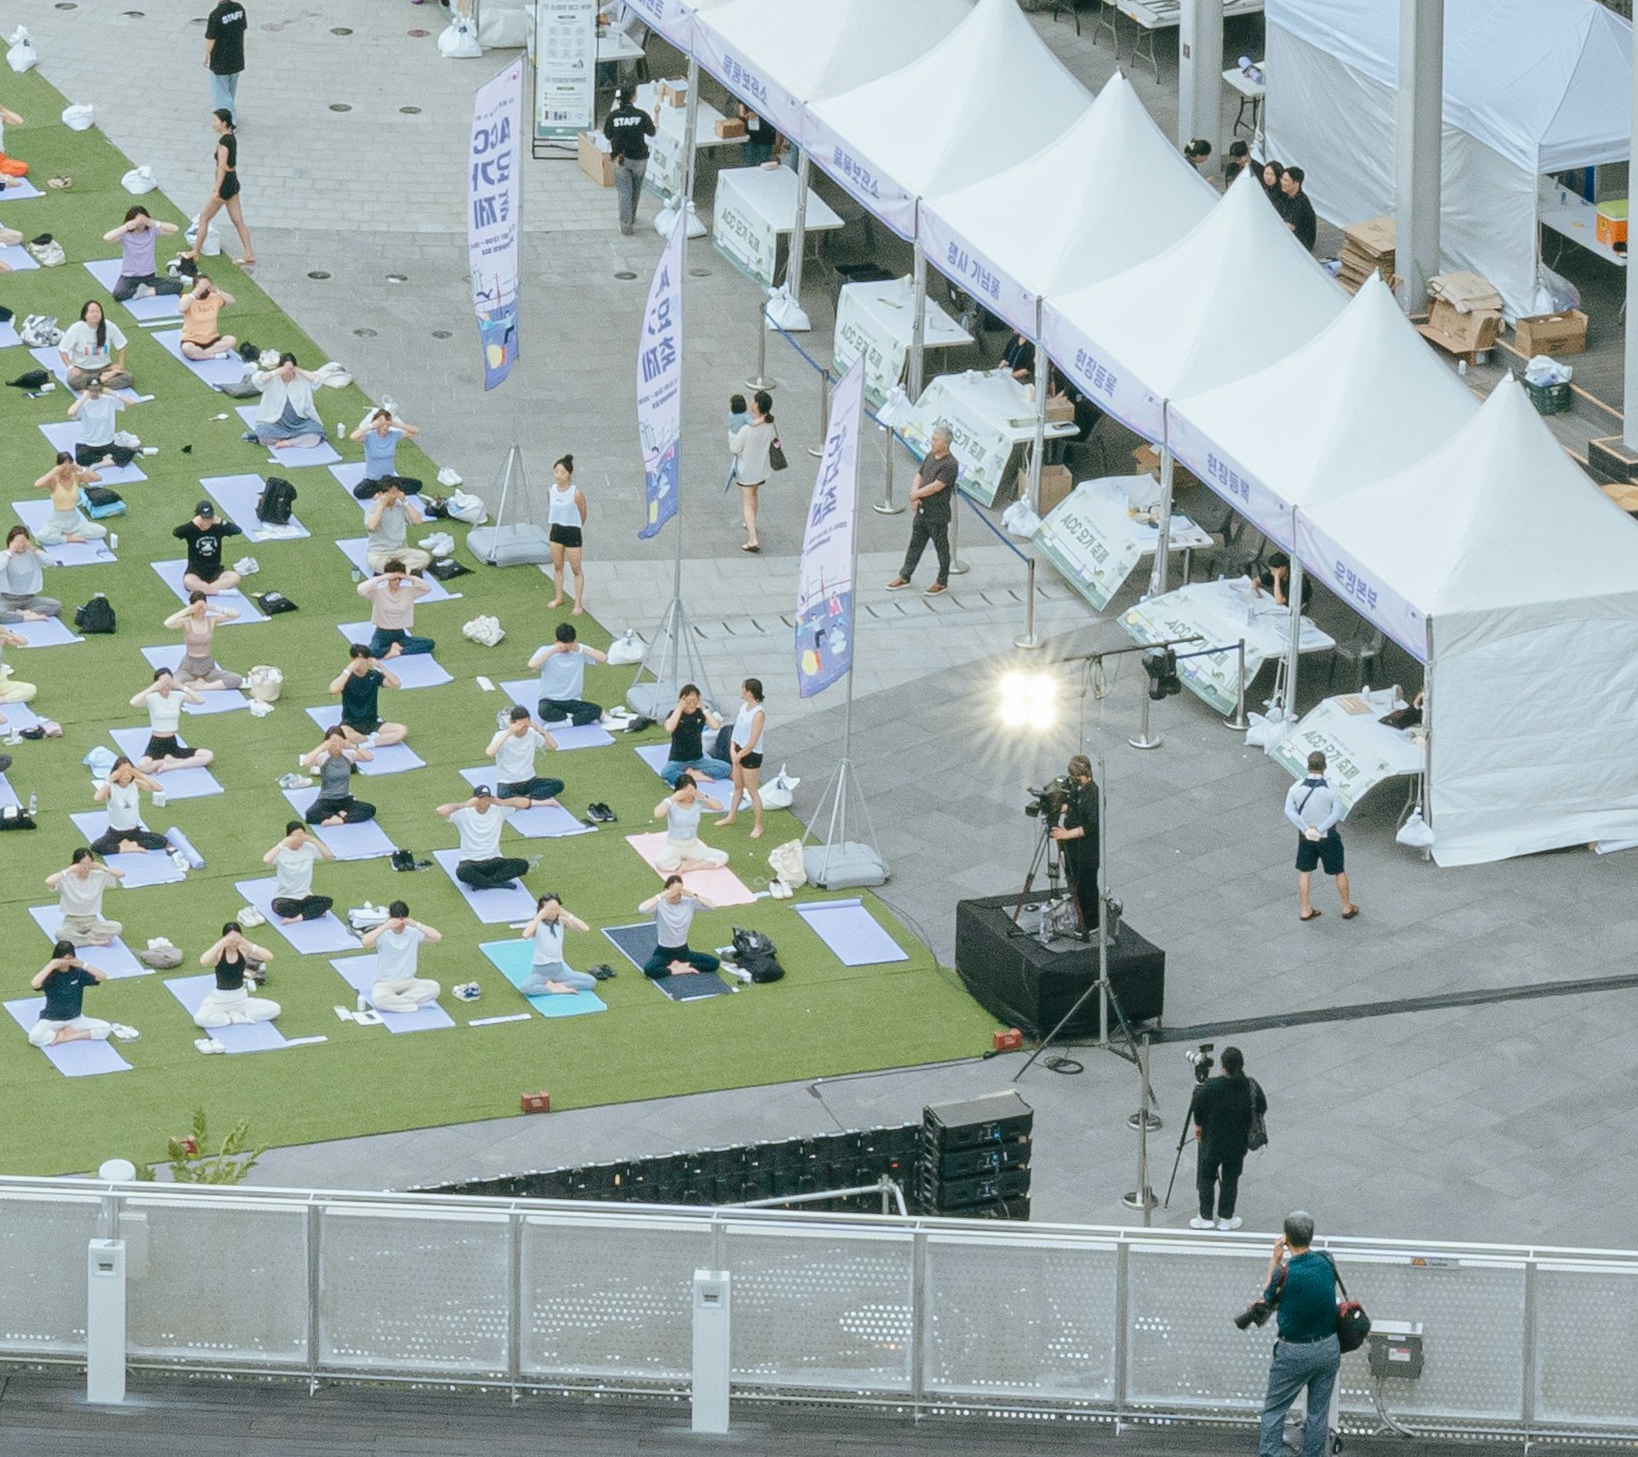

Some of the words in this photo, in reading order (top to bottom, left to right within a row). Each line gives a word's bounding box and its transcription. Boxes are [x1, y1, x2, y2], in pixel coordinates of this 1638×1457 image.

[221, 11, 243, 24] STAFF
[722, 54, 769, 106] 물품보관소
[613, 116, 642, 128] STAFF
[834, 145, 881, 201] 물품보관소
[721, 207, 736, 228] ACC
[928, 241, 948, 273] 행사
[950, 260, 981, 301] 기념품
[840, 322, 856, 345] ACC
[868, 348, 883, 369] 축제
[1075, 348, 1118, 398] 현장등록
[951, 424, 971, 449] 요가
[969, 439, 987, 463] 축제
[1207, 452, 1251, 504] 현장등록
[1060, 513, 1083, 535] ACC
[1077, 525, 1095, 550] 요가
[1089, 540, 1110, 565] 축제
[1334, 559, 1378, 611] 운영본부
[1163, 618, 1190, 640] ACC
[1302, 730, 1327, 749] ACC
[1322, 743, 1342, 763] 요가
[1335, 758, 1361, 781] 축제
